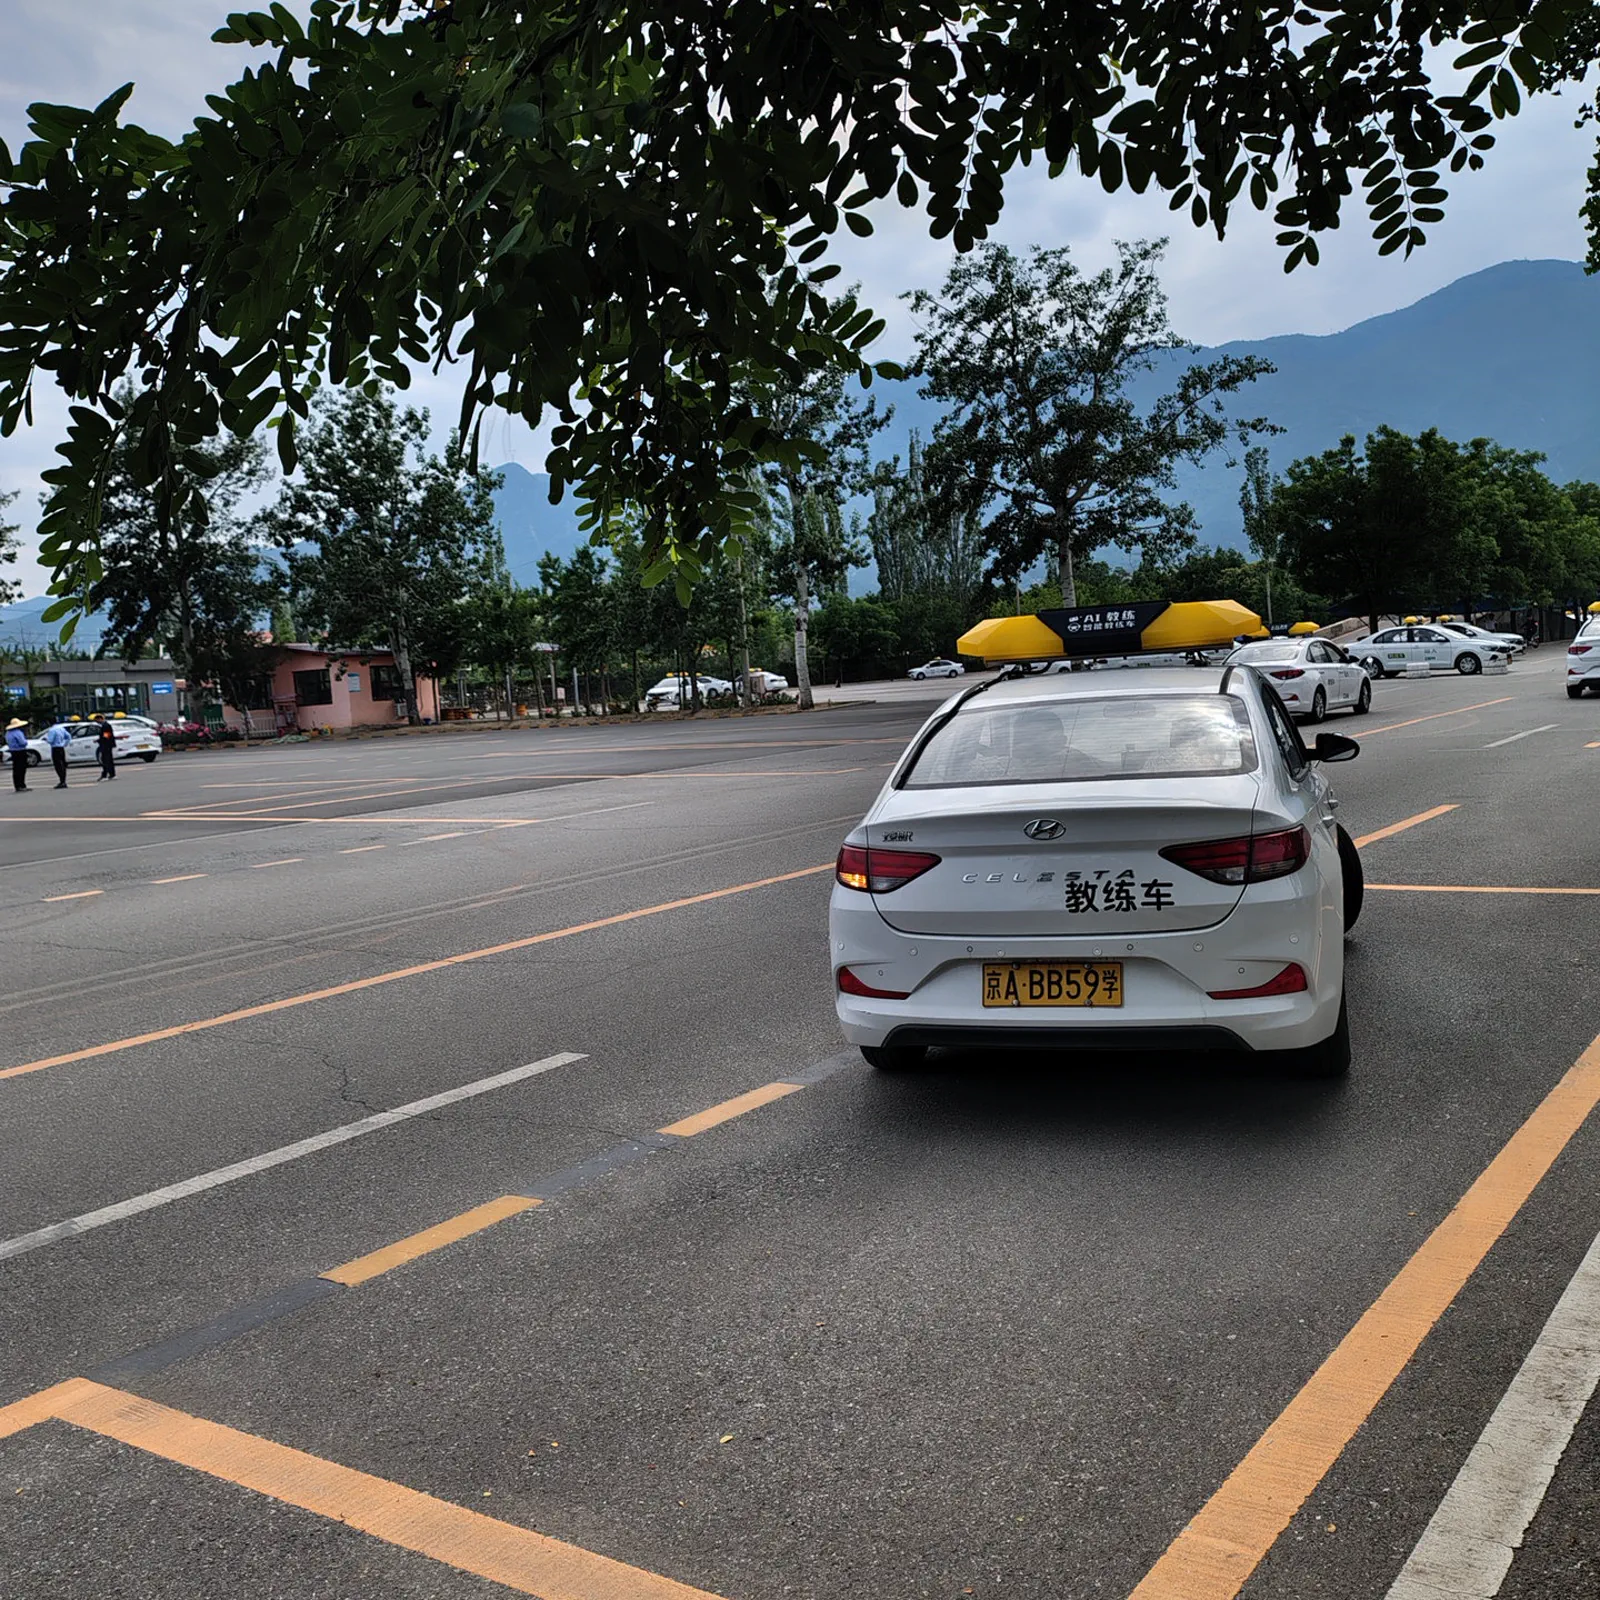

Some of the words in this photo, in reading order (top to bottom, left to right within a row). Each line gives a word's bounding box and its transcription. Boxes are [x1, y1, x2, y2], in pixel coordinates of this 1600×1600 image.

[1083, 614, 1101, 623] AI
[962, 869, 1136, 884] CELESTA
[1065, 879, 1175, 913] 教练车
